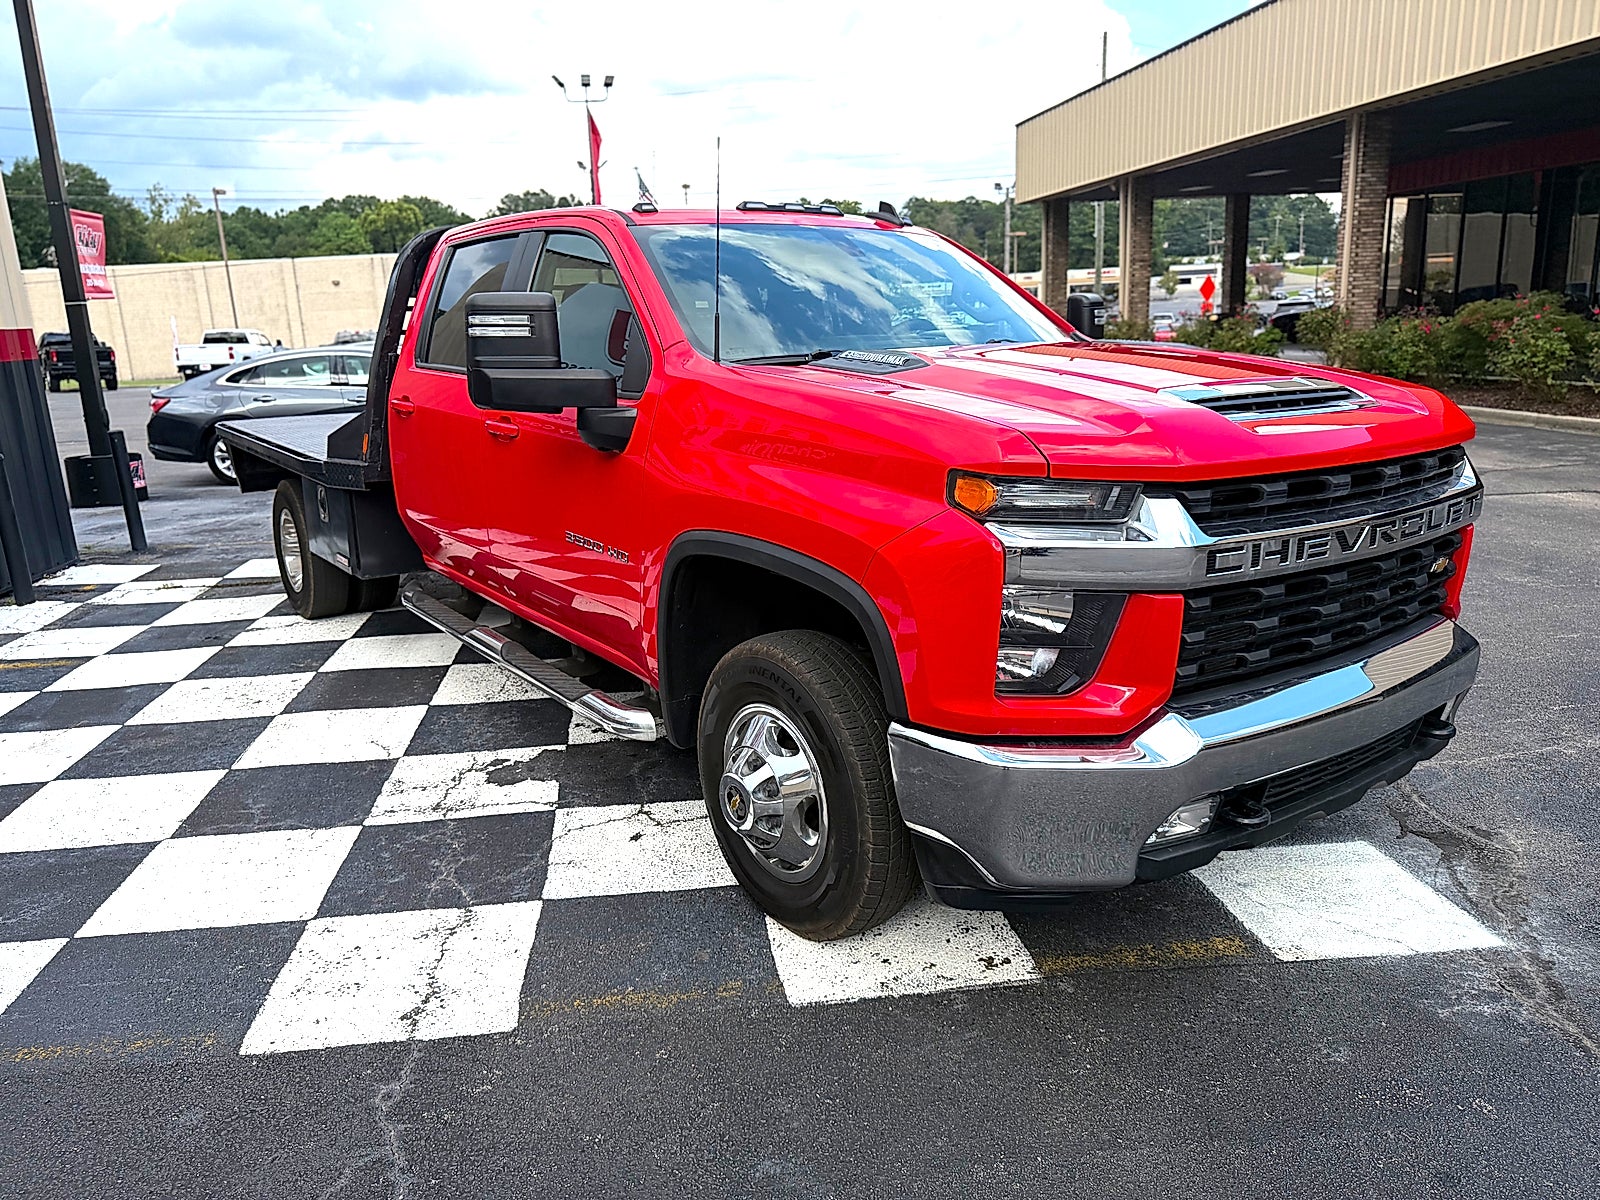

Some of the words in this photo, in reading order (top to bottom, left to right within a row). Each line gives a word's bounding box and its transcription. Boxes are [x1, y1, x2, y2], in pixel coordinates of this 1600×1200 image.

[865, 352, 908, 365] DURAMAX
[565, 530, 604, 554] 3500
[607, 546, 629, 563] HD
[1206, 495, 1481, 577] CHEVROLET
